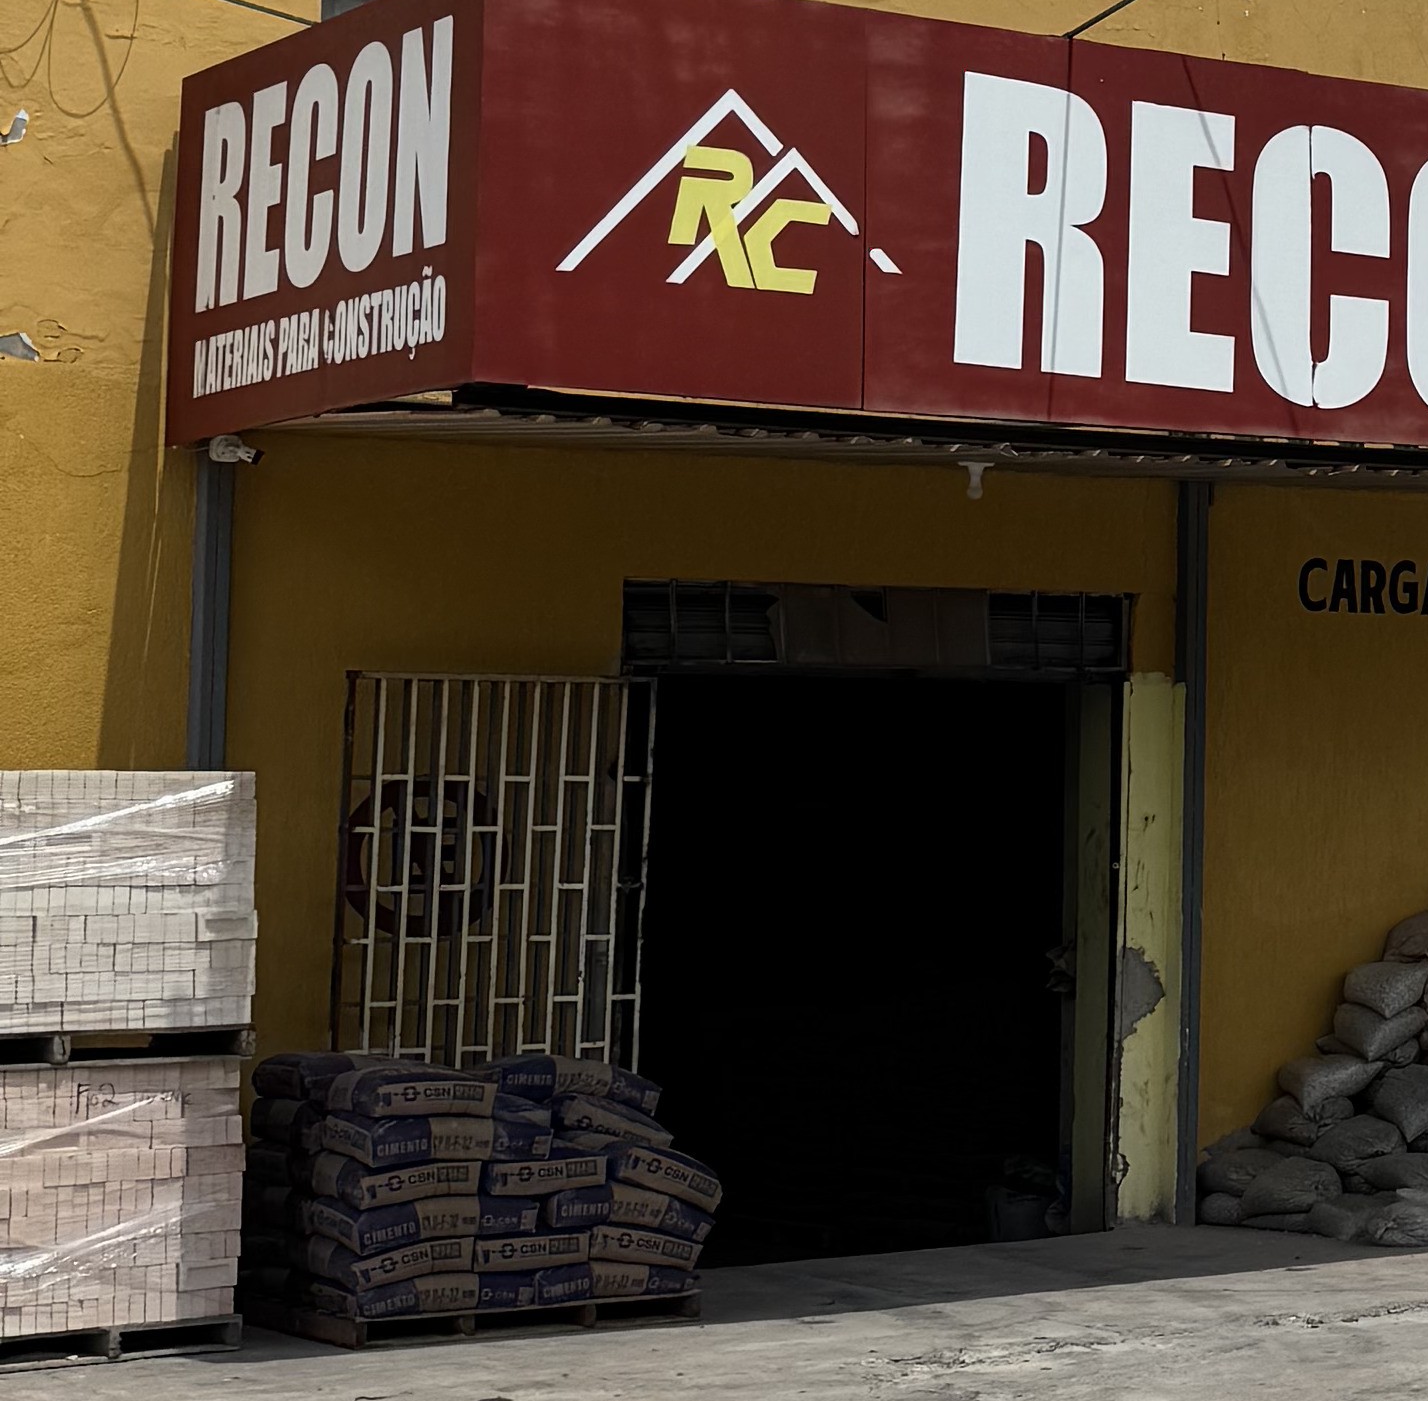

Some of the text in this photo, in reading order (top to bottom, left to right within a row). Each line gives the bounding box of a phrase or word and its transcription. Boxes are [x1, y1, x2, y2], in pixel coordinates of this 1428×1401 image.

[193, 15, 454, 313] RECON
[193, 265, 447, 399] MATERIAIS PARA CONSTRUÇÃO
[424, 1086, 452, 1099] CSN
[376, 1139, 429, 1158] CIMENTO
[408, 1169, 436, 1185] CSN
[538, 1165, 564, 1177] CSN
[664, 1166, 690, 1183] CSN
[560, 1202, 610, 1217] CIMENTO
[363, 1221, 417, 1247] CIMENTO
[520, 1242, 547, 1254] CSN
[636, 1238, 661, 1251] CSN
[401, 1249, 429, 1266] CSN
[363, 1294, 416, 1317] CIMENTO
